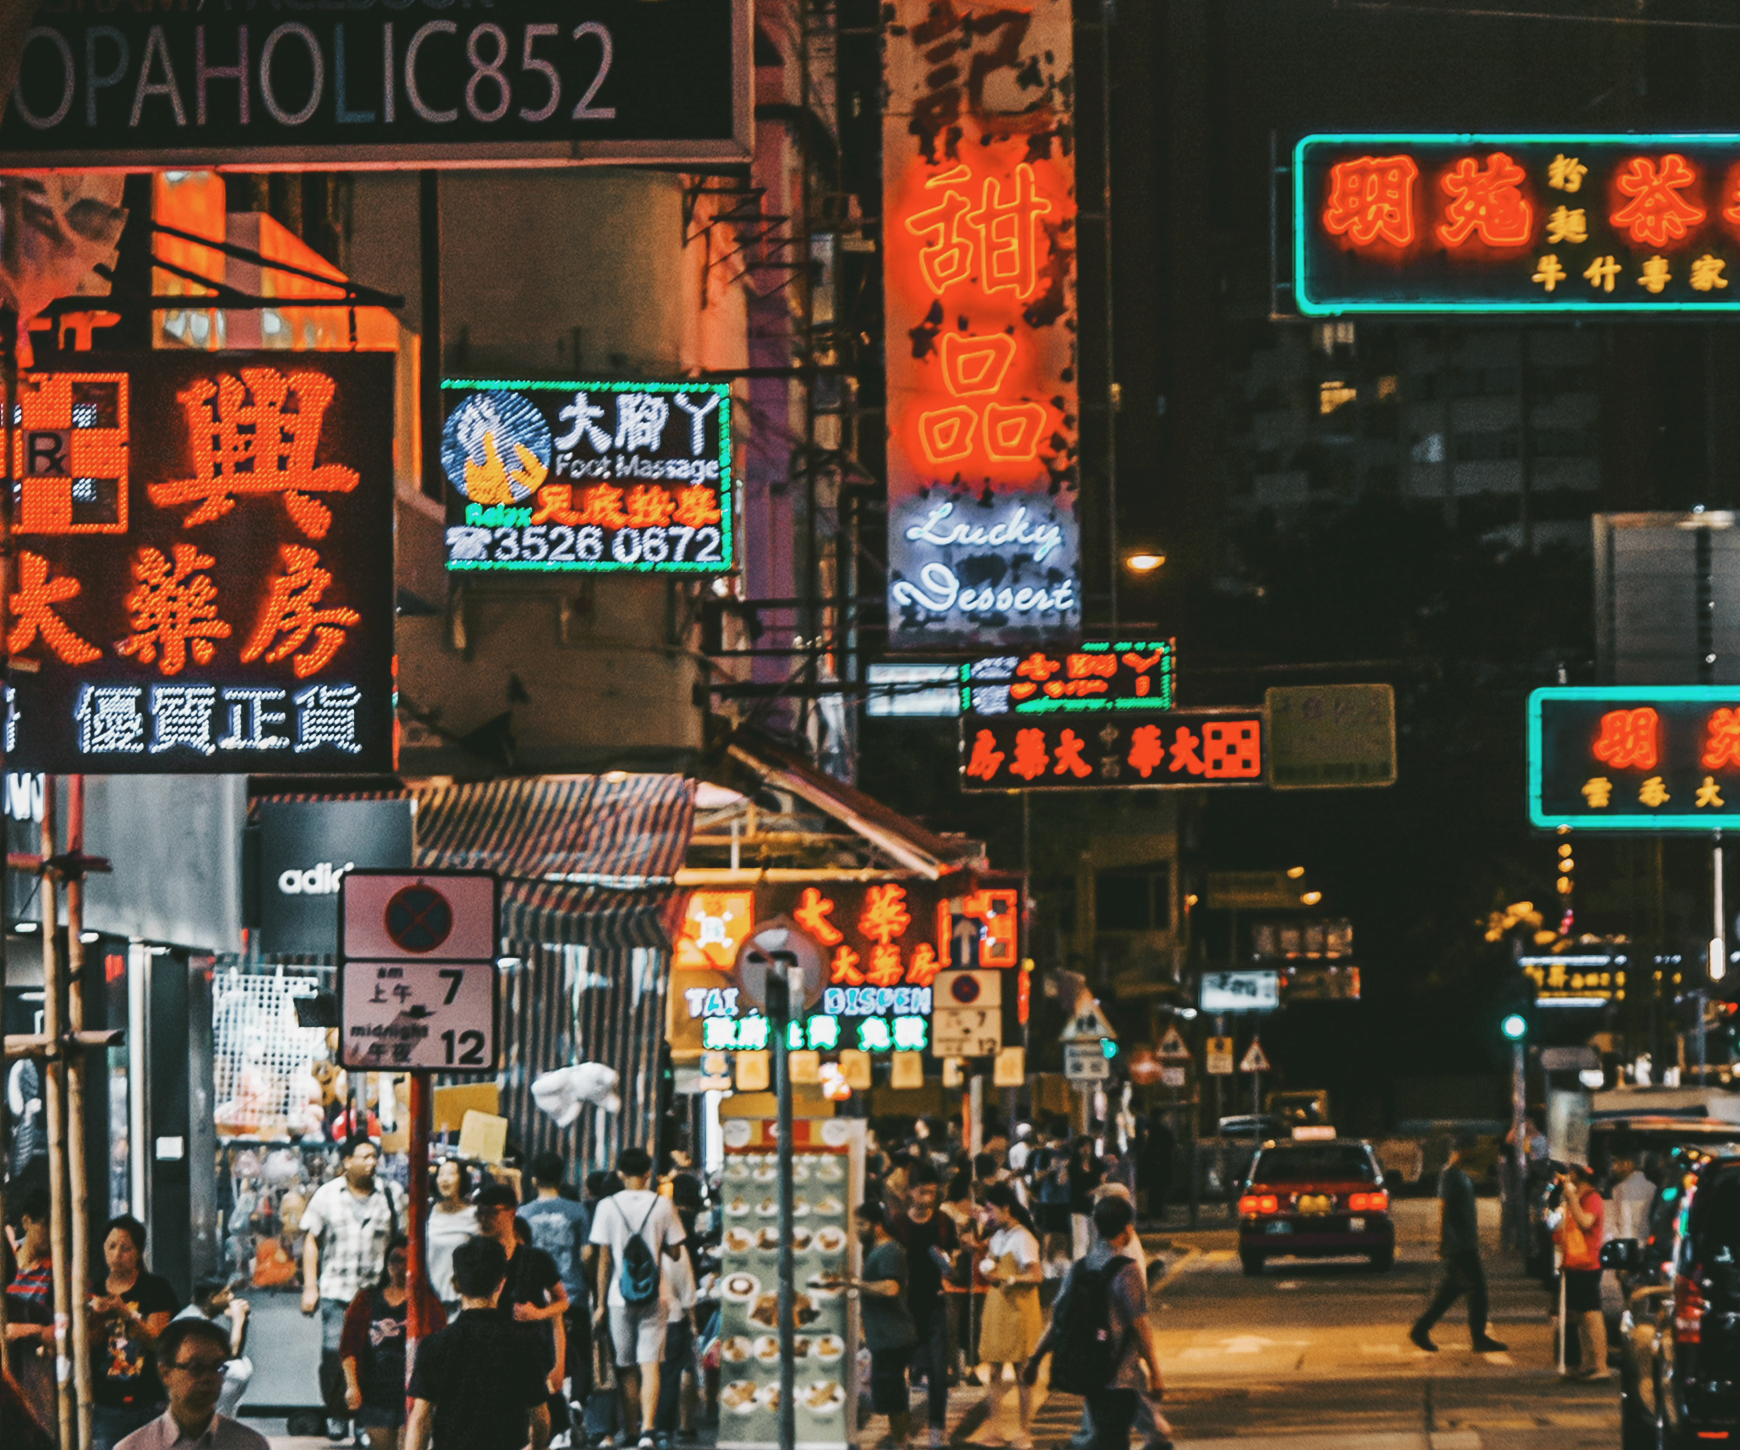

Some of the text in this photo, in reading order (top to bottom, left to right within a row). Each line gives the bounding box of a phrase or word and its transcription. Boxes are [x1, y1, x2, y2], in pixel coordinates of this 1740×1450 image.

[1531, 253, 1730, 294] 牛什專家
[149, 367, 360, 540] 興
[556, 453, 720, 486] Foot Massage
[493, 526, 722, 563] 3526 0672
[906, 501, 1062, 560] Lucky
[892, 562, 1075, 613] Dessert
[4, 543, 362, 677] 大藥房
[75, 683, 362, 755] 優質正貨
[369, 982, 413, 1004] 上午
[439, 969, 464, 1005] 7
[440, 1029, 486, 1064] 12
